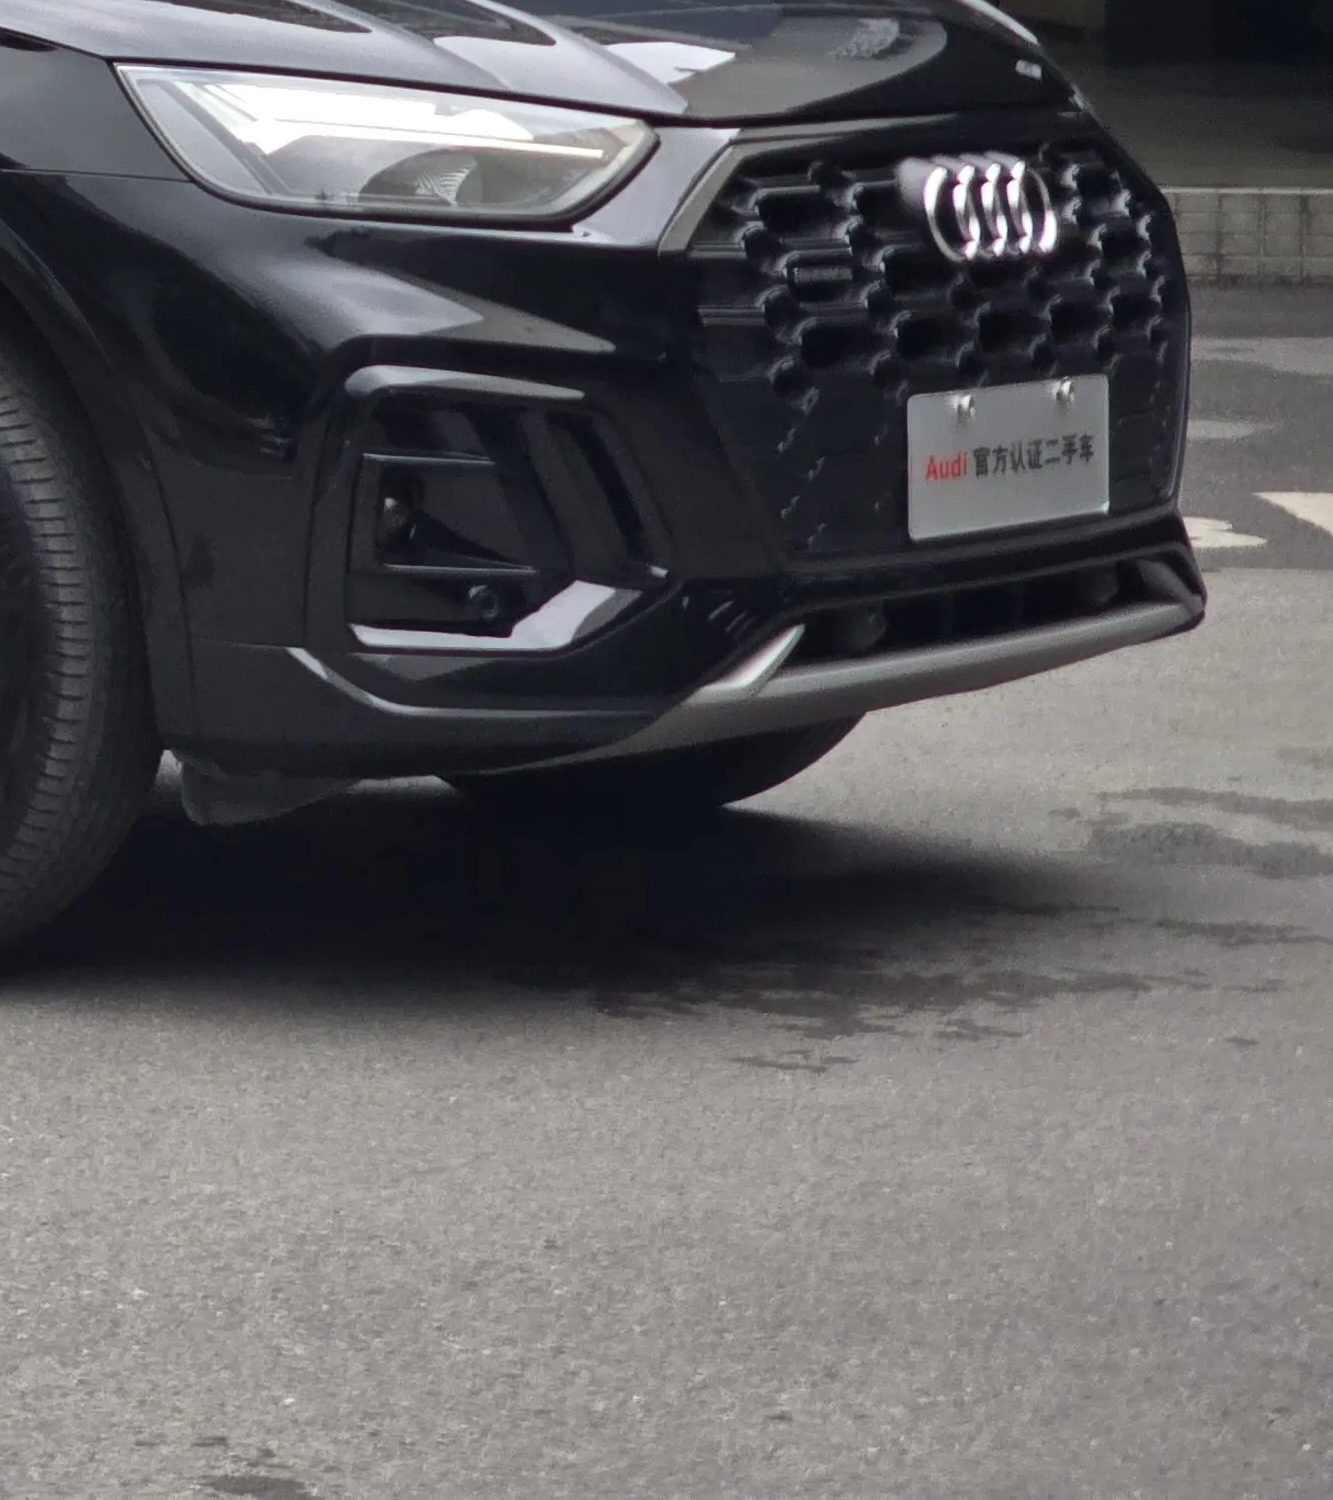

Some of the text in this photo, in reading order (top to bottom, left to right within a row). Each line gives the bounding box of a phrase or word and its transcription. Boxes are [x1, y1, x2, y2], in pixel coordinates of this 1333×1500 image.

[925, 433, 1094, 481] Audi 官方认证二手车
